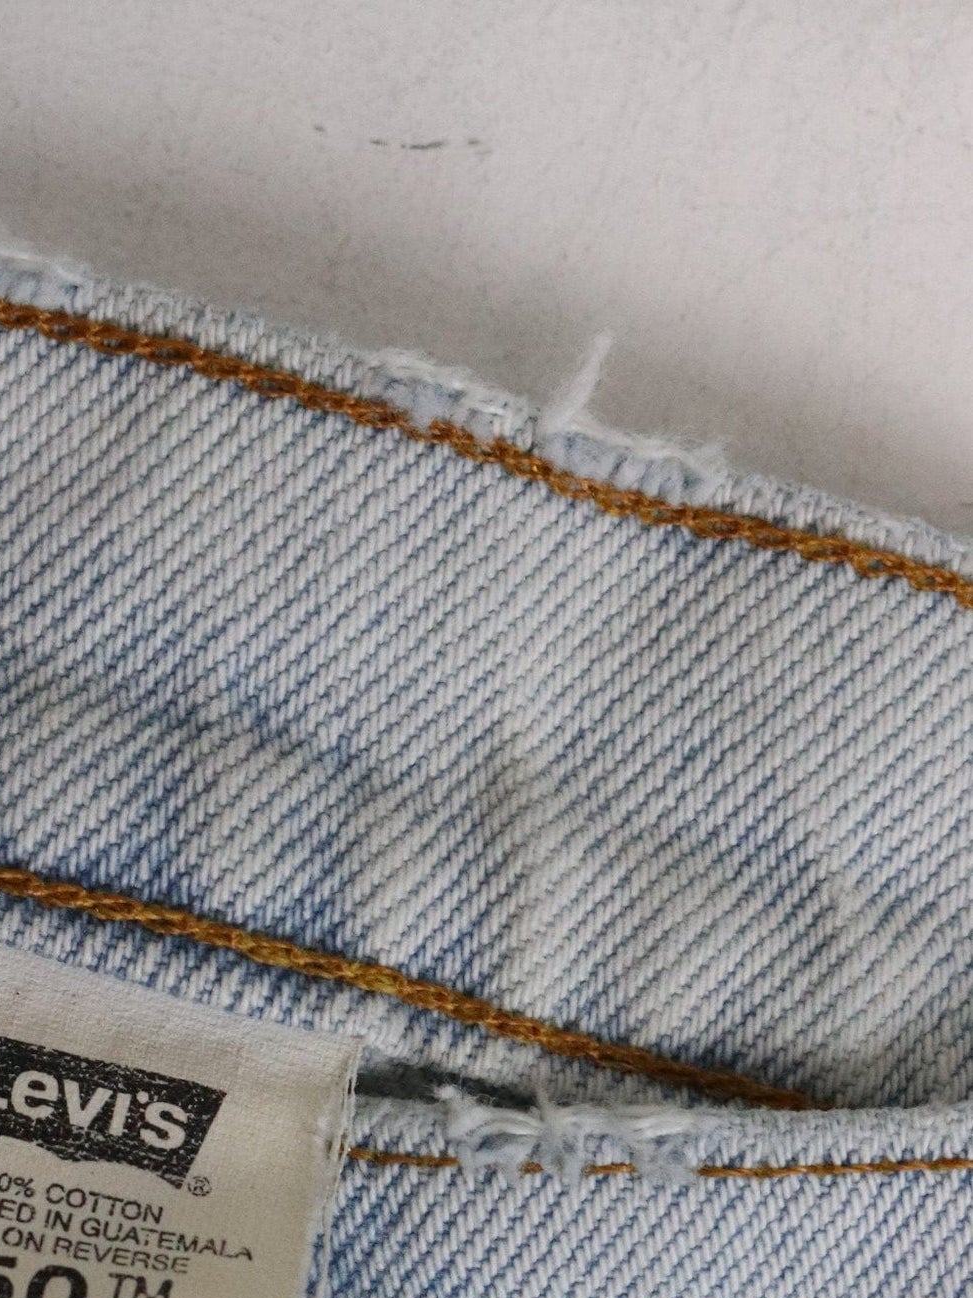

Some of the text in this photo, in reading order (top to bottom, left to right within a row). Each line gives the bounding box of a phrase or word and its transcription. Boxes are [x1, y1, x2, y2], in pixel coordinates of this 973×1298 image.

[45, 1183, 164, 1223] COTTON
[1, 1225, 45, 1253] ON
[51, 1236, 192, 1274] REVERSE
[44, 1207, 73, 1233] IN
[80, 1218, 254, 1262] GUATEMALA
